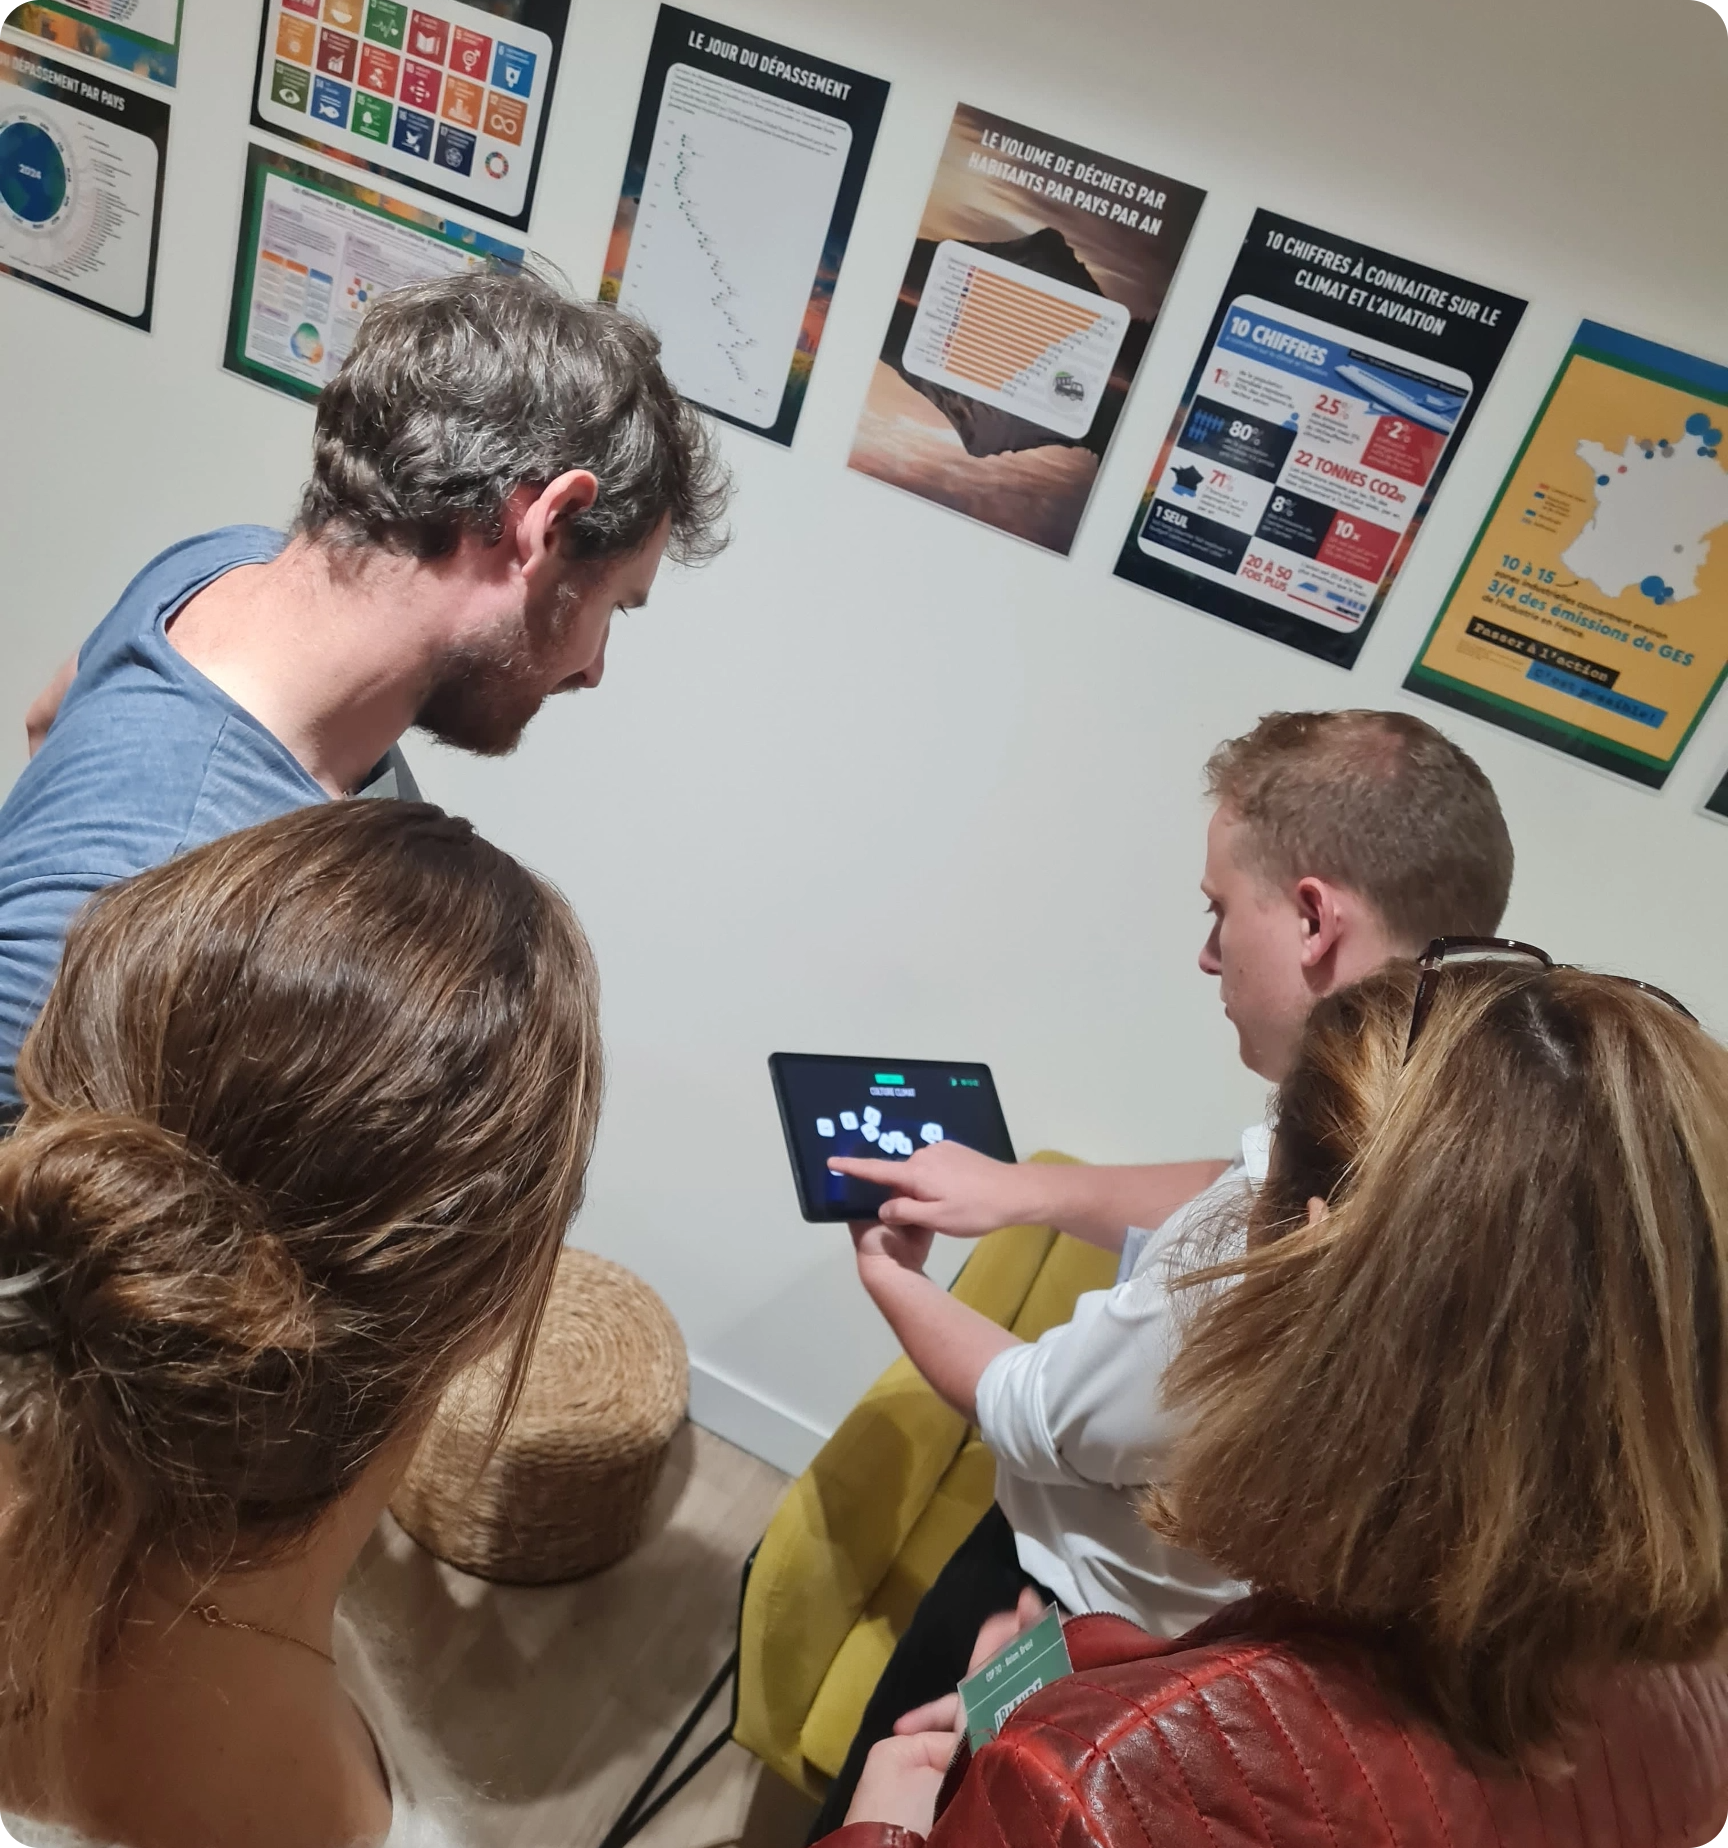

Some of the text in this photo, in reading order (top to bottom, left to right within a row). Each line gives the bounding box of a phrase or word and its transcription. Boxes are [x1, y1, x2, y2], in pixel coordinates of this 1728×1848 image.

[12, 56, 79, 94] DÉPASSEMENT
[80, 82, 100, 101] PAR
[101, 90, 125, 111] PAYS
[688, 31, 851, 100] LE JOUR DU DÉPASSEMENT
[966, 151, 1163, 236] HABITANTS PAR PAYS PAR AN
[979, 127, 1167, 210] LE VOLUME DE DÉCHETS PAR
[1266, 231, 1501, 326] 10 CHIFFRES À CONNAITRE SUR LE
[1295, 270, 1446, 335] CLIMAT ET L'AVIATION
[1231, 317, 1250, 337] 10
[1252, 325, 1328, 365] CHIFFRES
[1229, 419, 1261, 446] 80%
[1294, 449, 1311, 466] 22
[1313, 457, 1367, 487] TONNES
[1155, 505, 1162, 518] 1
[1160, 507, 1190, 529] SEUL
[1271, 496, 1294, 517] 8%
[1242, 567, 1287, 591] FOIS PLUS
[1245, 554, 1262, 569] 20
[1276, 565, 1292, 580] 50
[1502, 554, 1555, 583] 10 à 15
[1487, 579, 1694, 667] 3/4 des émissions de GES
[1473, 621, 1524, 649] Passer
[1540, 649, 1609, 682] l'action
